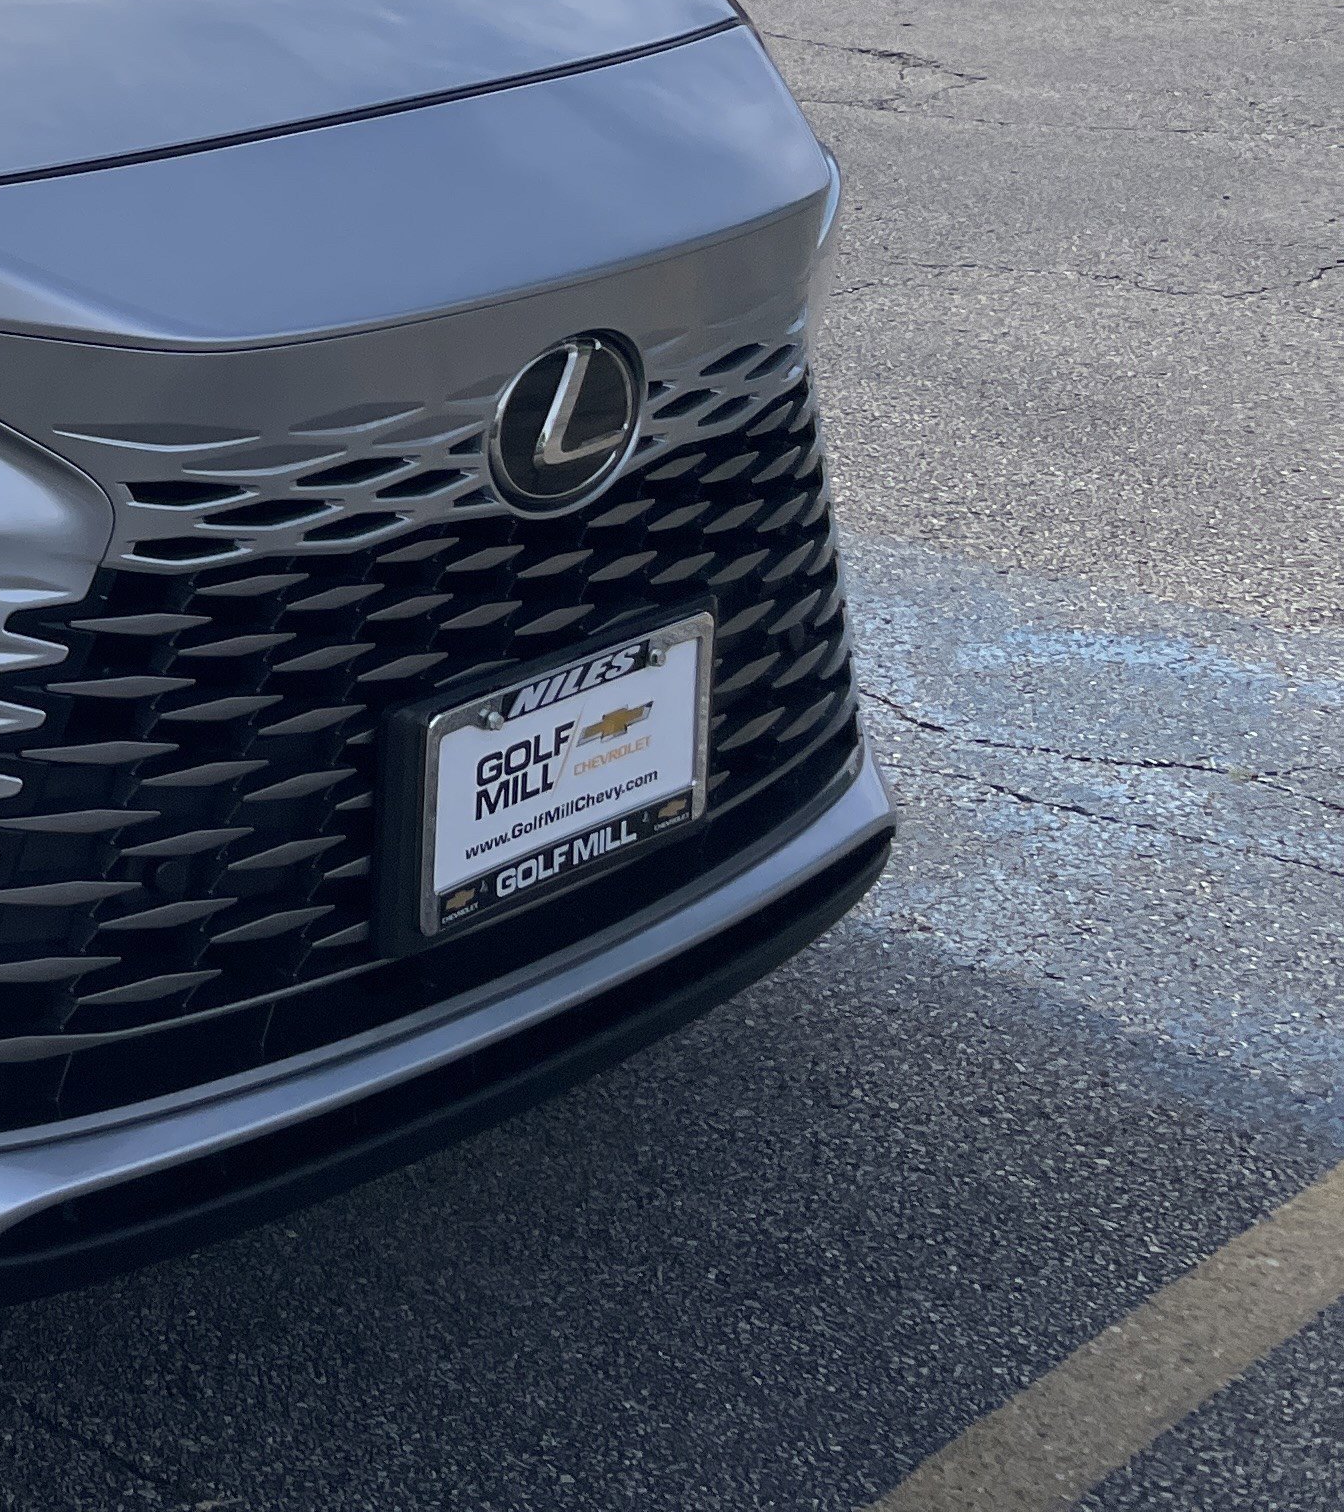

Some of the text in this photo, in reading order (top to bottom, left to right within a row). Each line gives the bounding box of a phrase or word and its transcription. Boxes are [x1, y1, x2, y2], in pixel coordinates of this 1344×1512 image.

[508, 644, 642, 719] NILES
[476, 720, 575, 788] GOLF
[572, 734, 652, 777] CHEVROLET
[464, 769, 659, 860] www.GolfMillChevy.com
[475, 763, 555, 821] MILL
[495, 820, 637, 899] GOLF MILL
